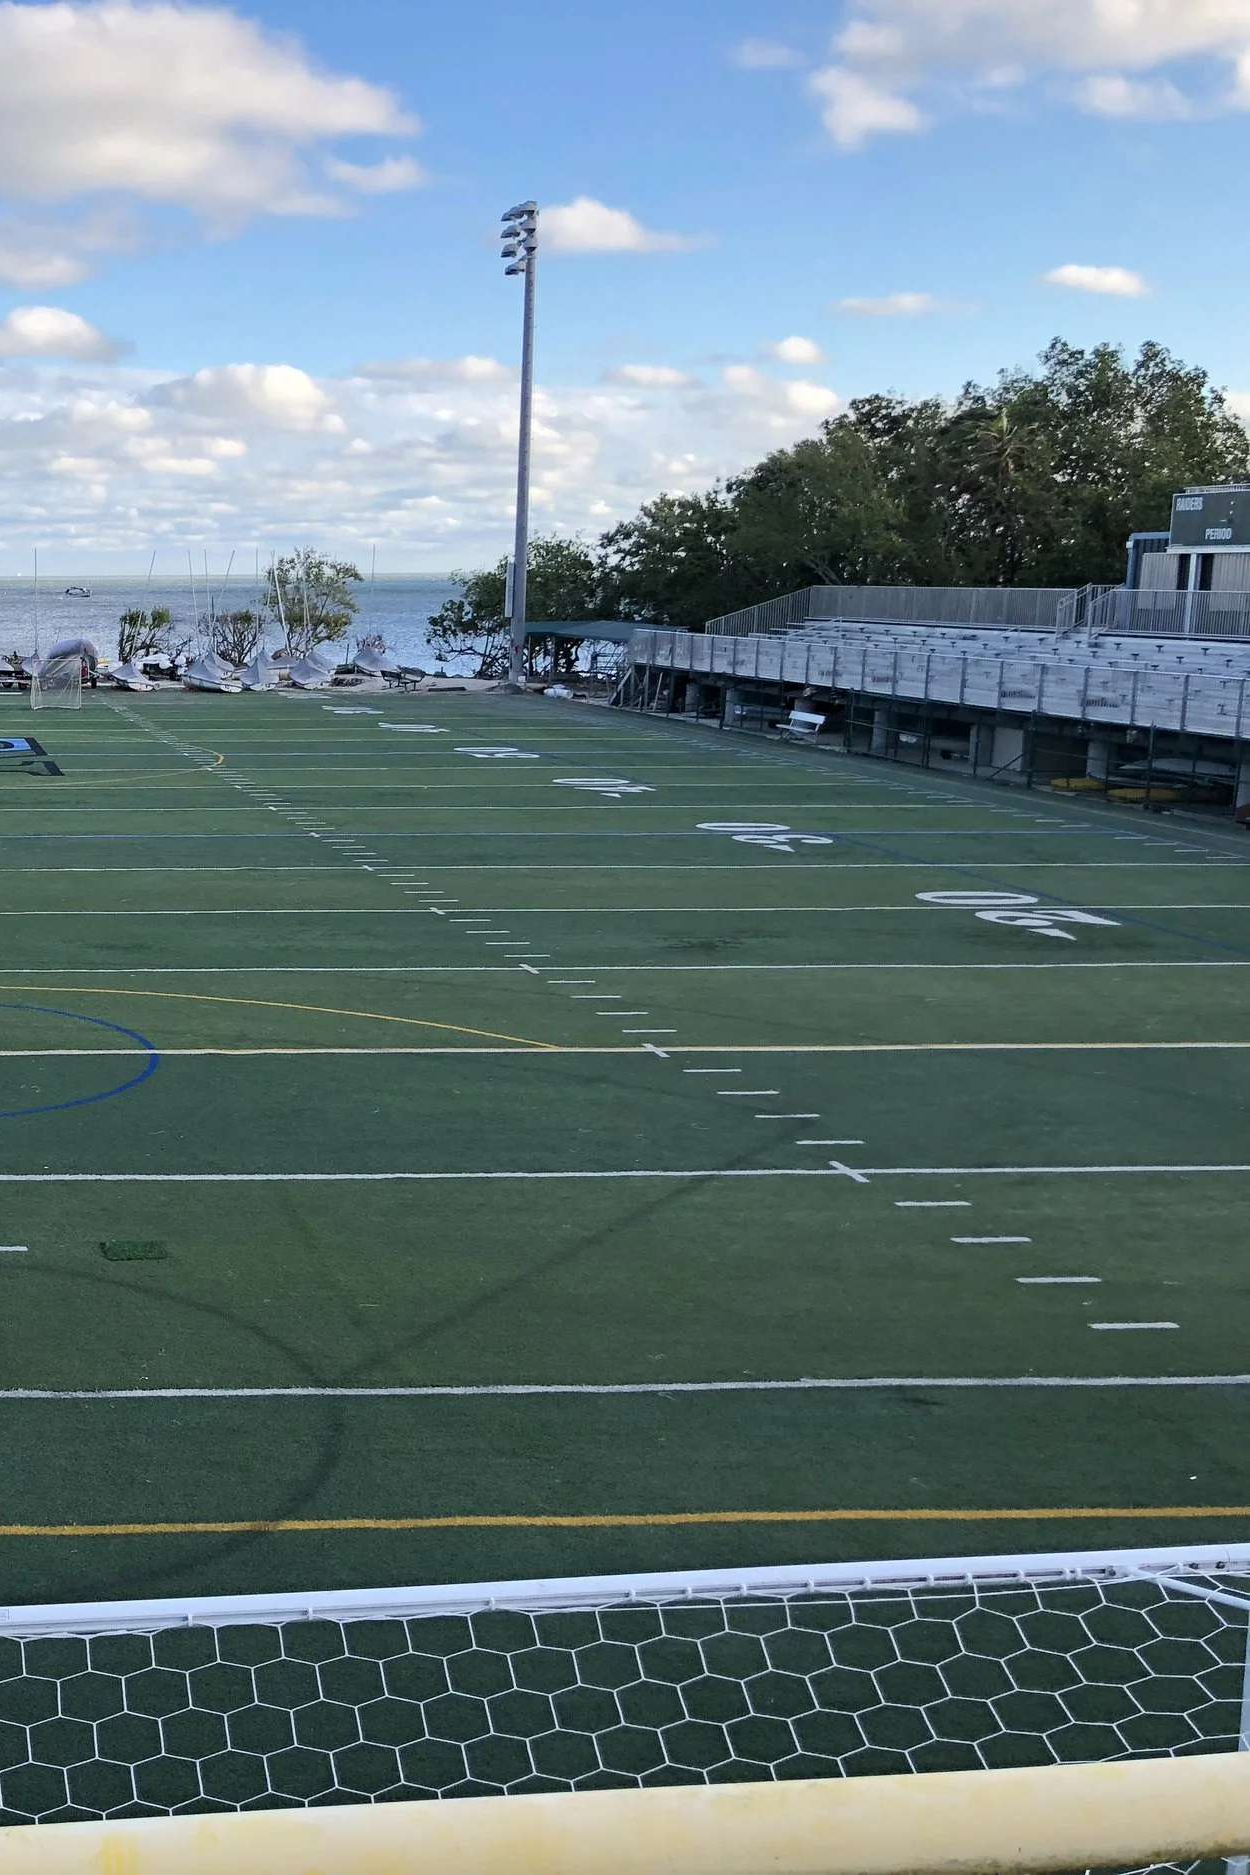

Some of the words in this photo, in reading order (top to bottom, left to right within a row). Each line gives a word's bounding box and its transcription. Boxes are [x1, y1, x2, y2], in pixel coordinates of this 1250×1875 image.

[1176, 497, 1203, 511] RAIDERS
[1205, 528, 1232, 540] PERIOD
[552, 778, 656, 793] 40
[695, 822, 834, 844] 30
[915, 891, 1121, 927] 20
